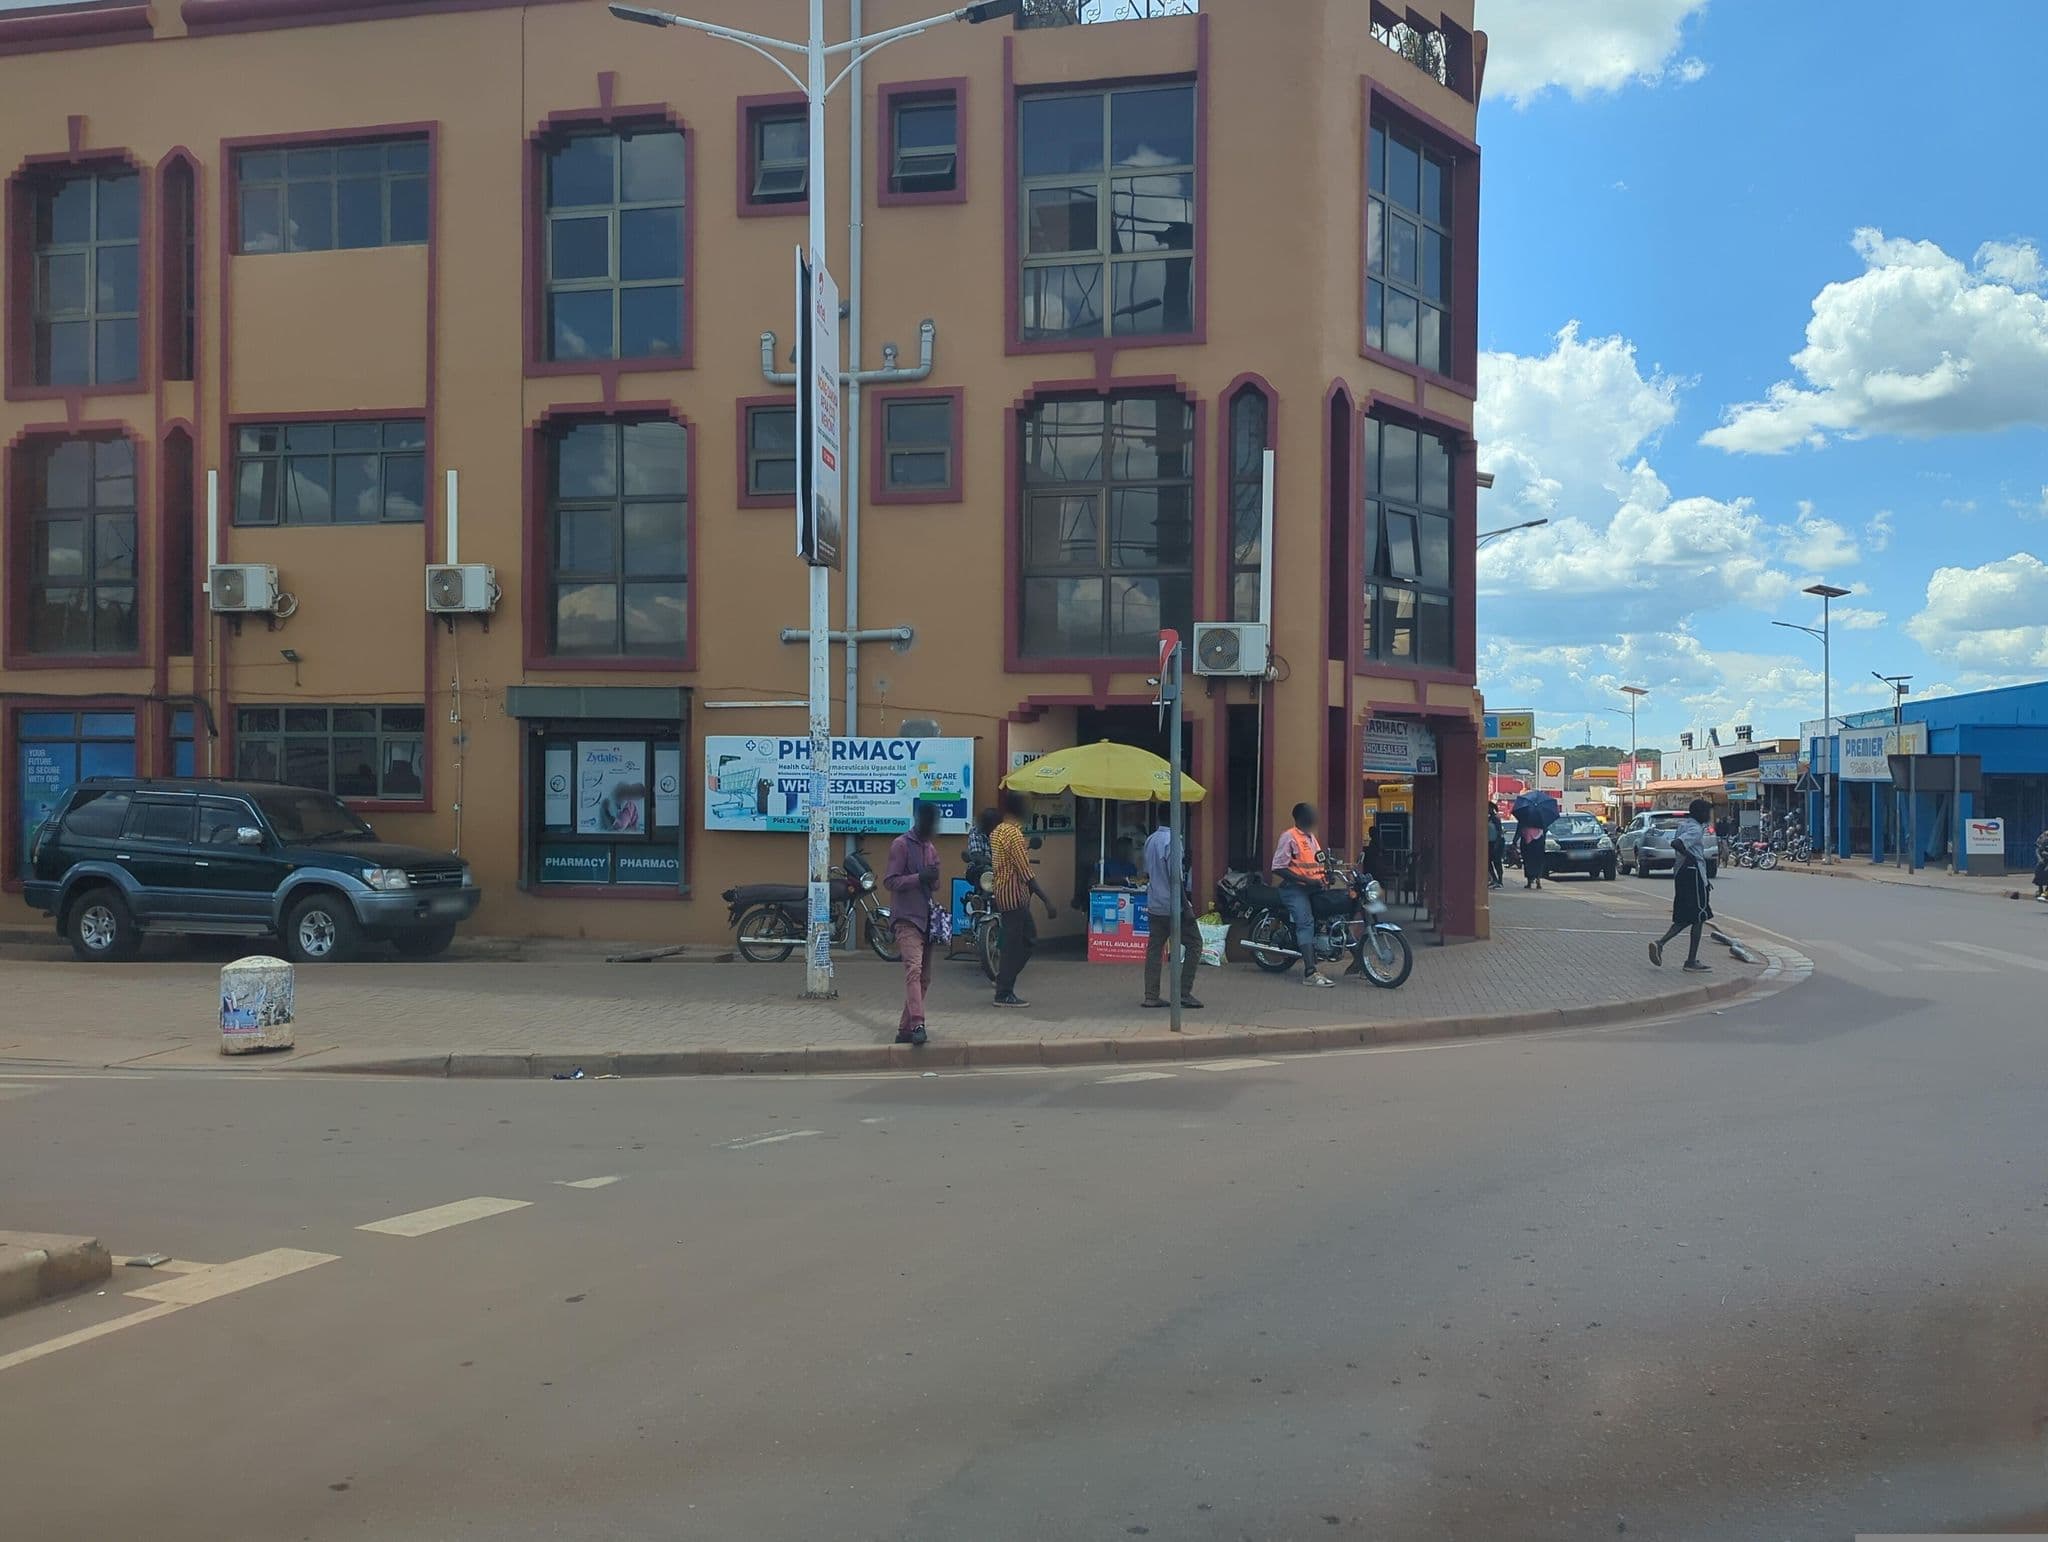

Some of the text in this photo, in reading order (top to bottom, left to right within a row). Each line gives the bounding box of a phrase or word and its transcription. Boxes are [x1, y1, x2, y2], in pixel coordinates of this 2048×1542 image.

[1366, 719, 1408, 735] ARMACY
[778, 740, 921, 761] PHRMACY
[1845, 736, 1883, 757] PREMIER
[28, 757, 53, 766] FUTURE
[28, 766, 35, 774] IS
[28, 775, 60, 783] WITH OUR
[50, 784, 60, 792] OF
[783, 780, 892, 793] WHESALERS
[545, 857, 680, 869] PHARMACY PHARMACY
